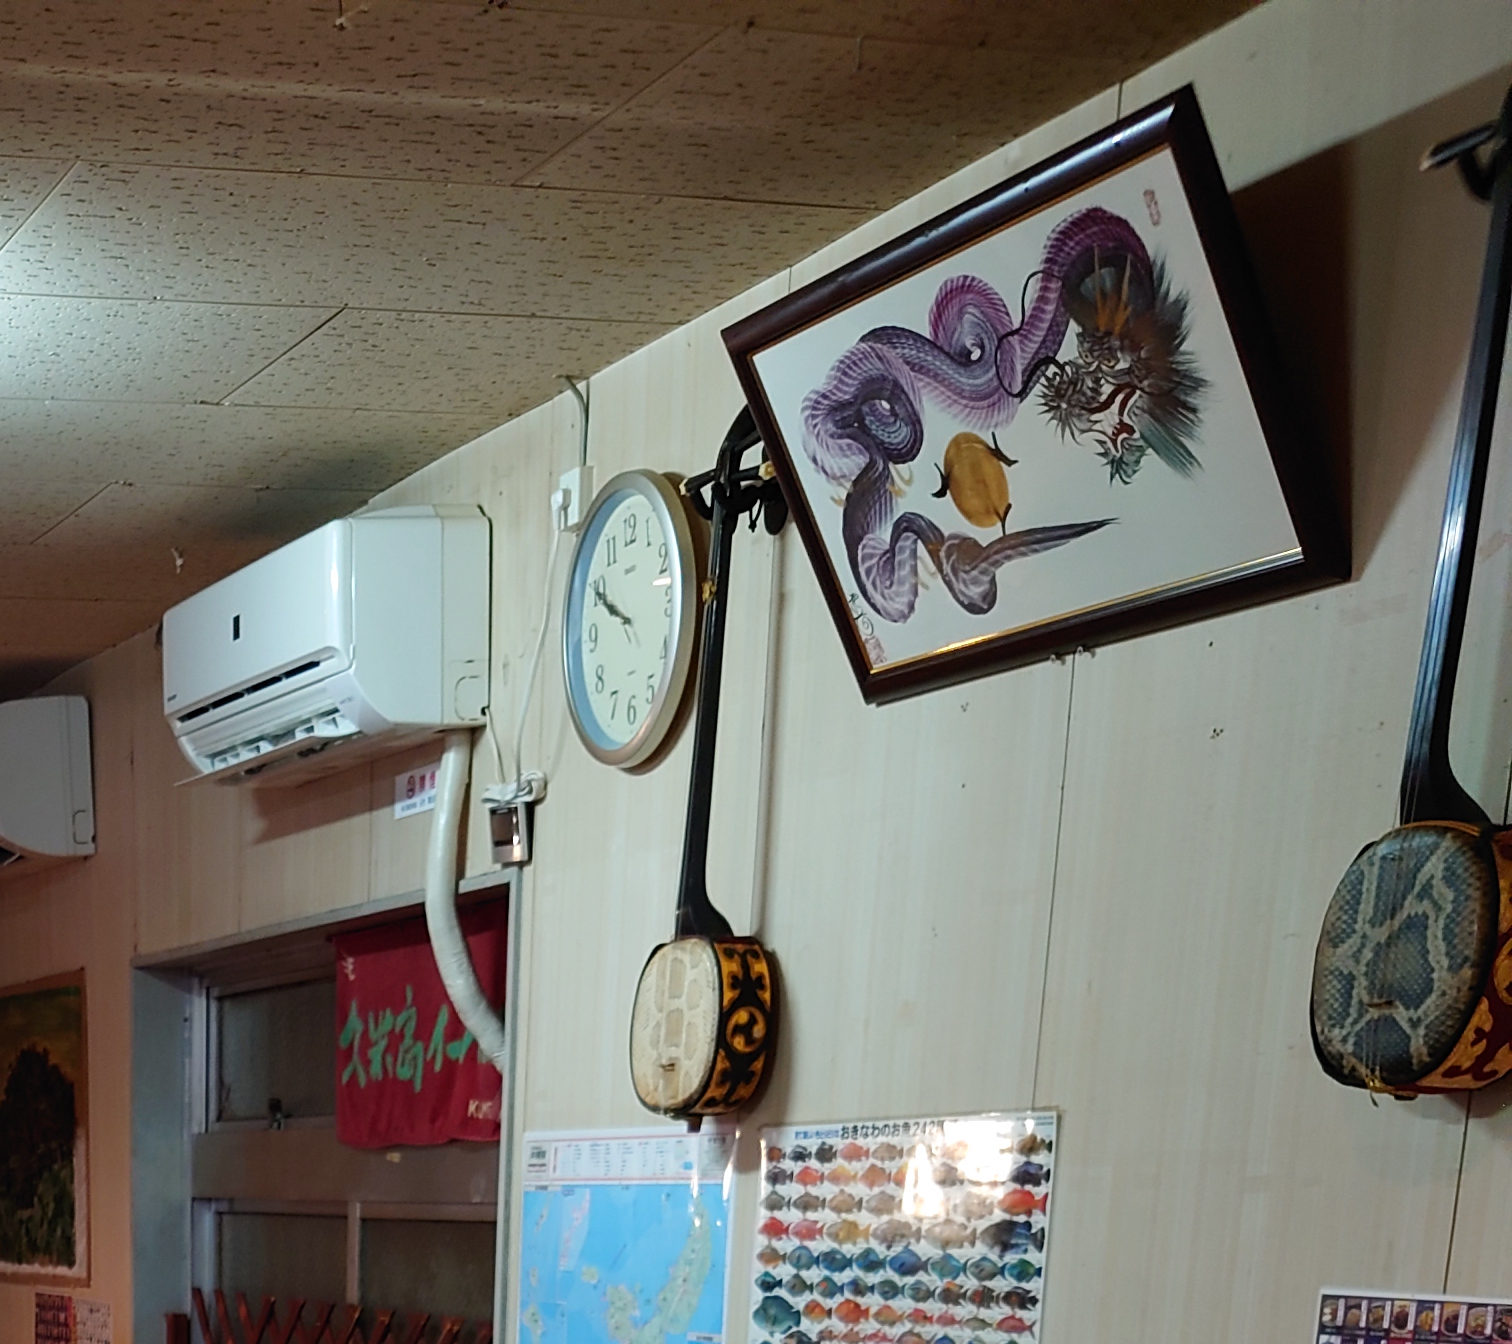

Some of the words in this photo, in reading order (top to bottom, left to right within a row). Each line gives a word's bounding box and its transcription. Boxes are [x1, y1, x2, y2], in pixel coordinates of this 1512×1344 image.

[623, 513, 637, 547] 12
[646, 517, 652, 548] 1
[605, 534, 618, 567] 11
[658, 542, 668, 575] 2
[588, 623, 599, 653] 9
[595, 664, 605, 694] 8
[646, 674, 655, 705] 5
[609, 690, 619, 721] 7
[626, 695, 636, 726] 6
